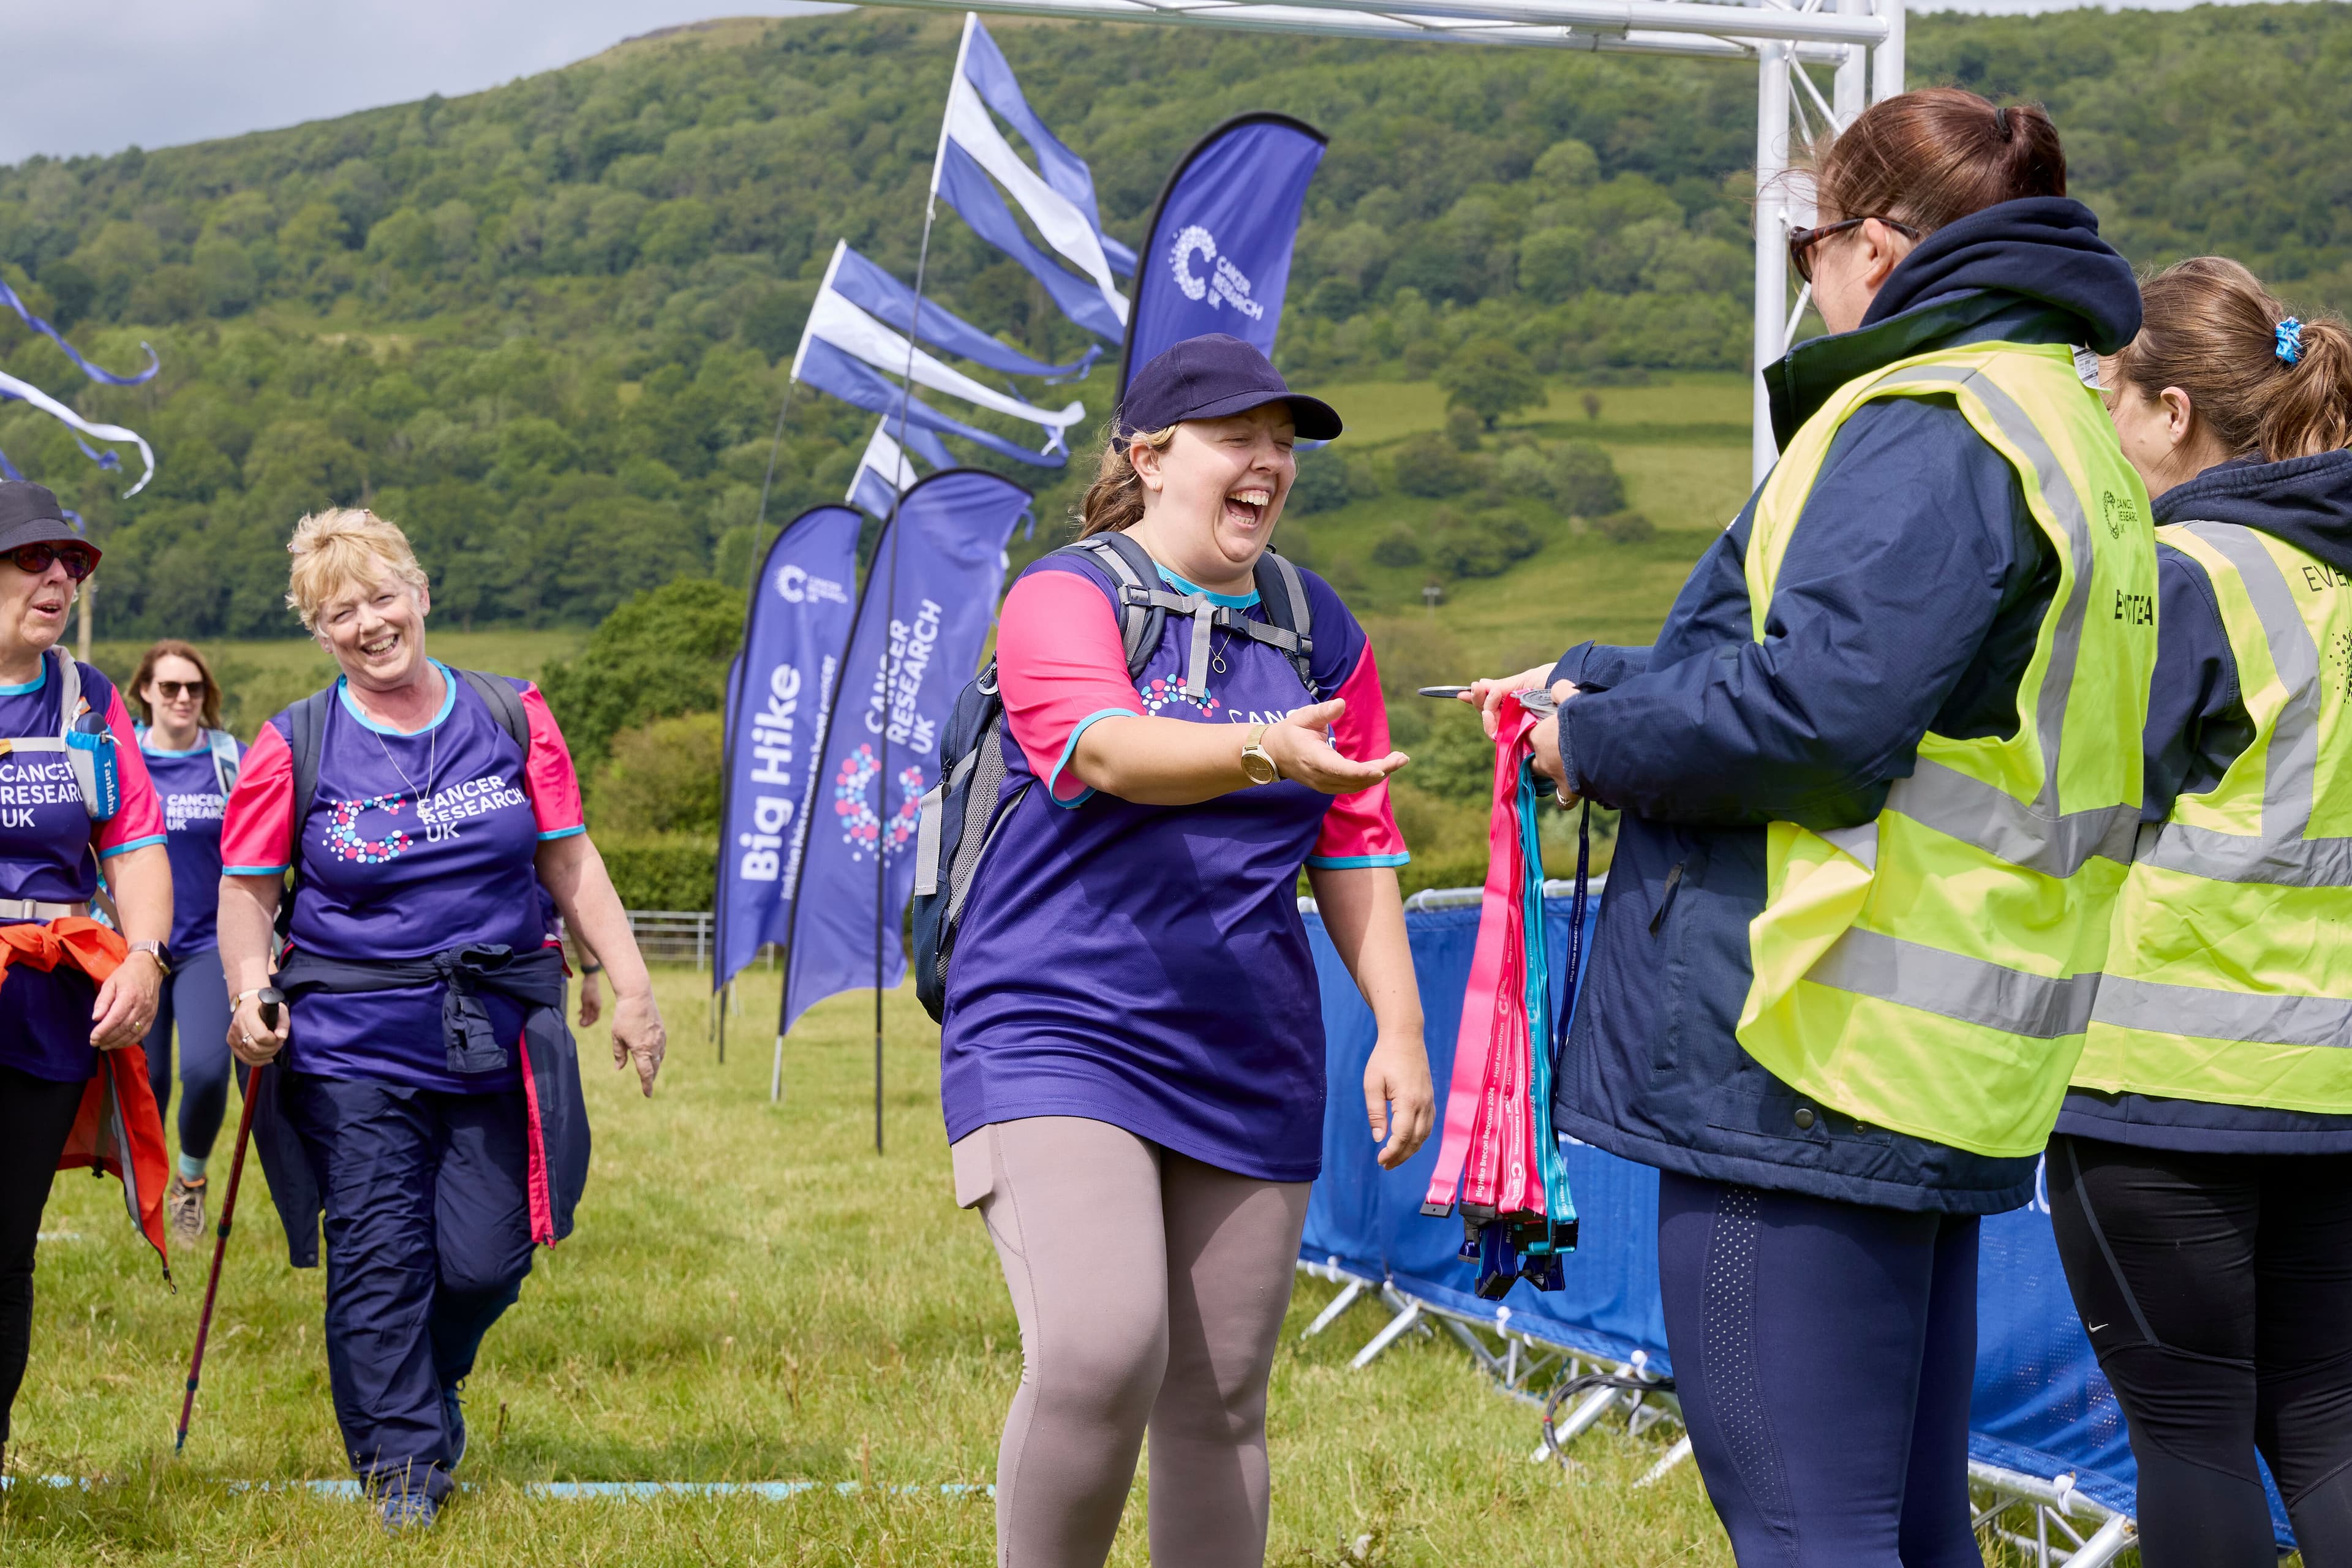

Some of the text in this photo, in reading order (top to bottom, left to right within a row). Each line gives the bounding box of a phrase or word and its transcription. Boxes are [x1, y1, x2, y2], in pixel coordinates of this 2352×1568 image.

[2302, 563, 2351, 592] EVE
[865, 619, 911, 734] CANCER
[886, 598, 942, 745] RESEARCH
[751, 663, 801, 785] Hike
[1229, 709, 1299, 725] CAN
[910, 713, 935, 755] UK
[0, 783, 83, 805] RESEAR
[104, 759, 116, 815] Tanluhu
[417, 775, 506, 811] CANCER
[2, 808, 36, 827] UK
[166, 805, 225, 820] RESEARC
[421, 788, 526, 824] RESEARCH
[166, 818, 187, 831] UK
[426, 821, 461, 842] UK
[740, 796, 794, 881] Big
[1483, 1107, 1493, 1139] Beacons
[1480, 1140, 1489, 1166] Brecon
[1477, 1167, 1487, 1184] Hike
[1476, 1184, 1485, 1197] Big
